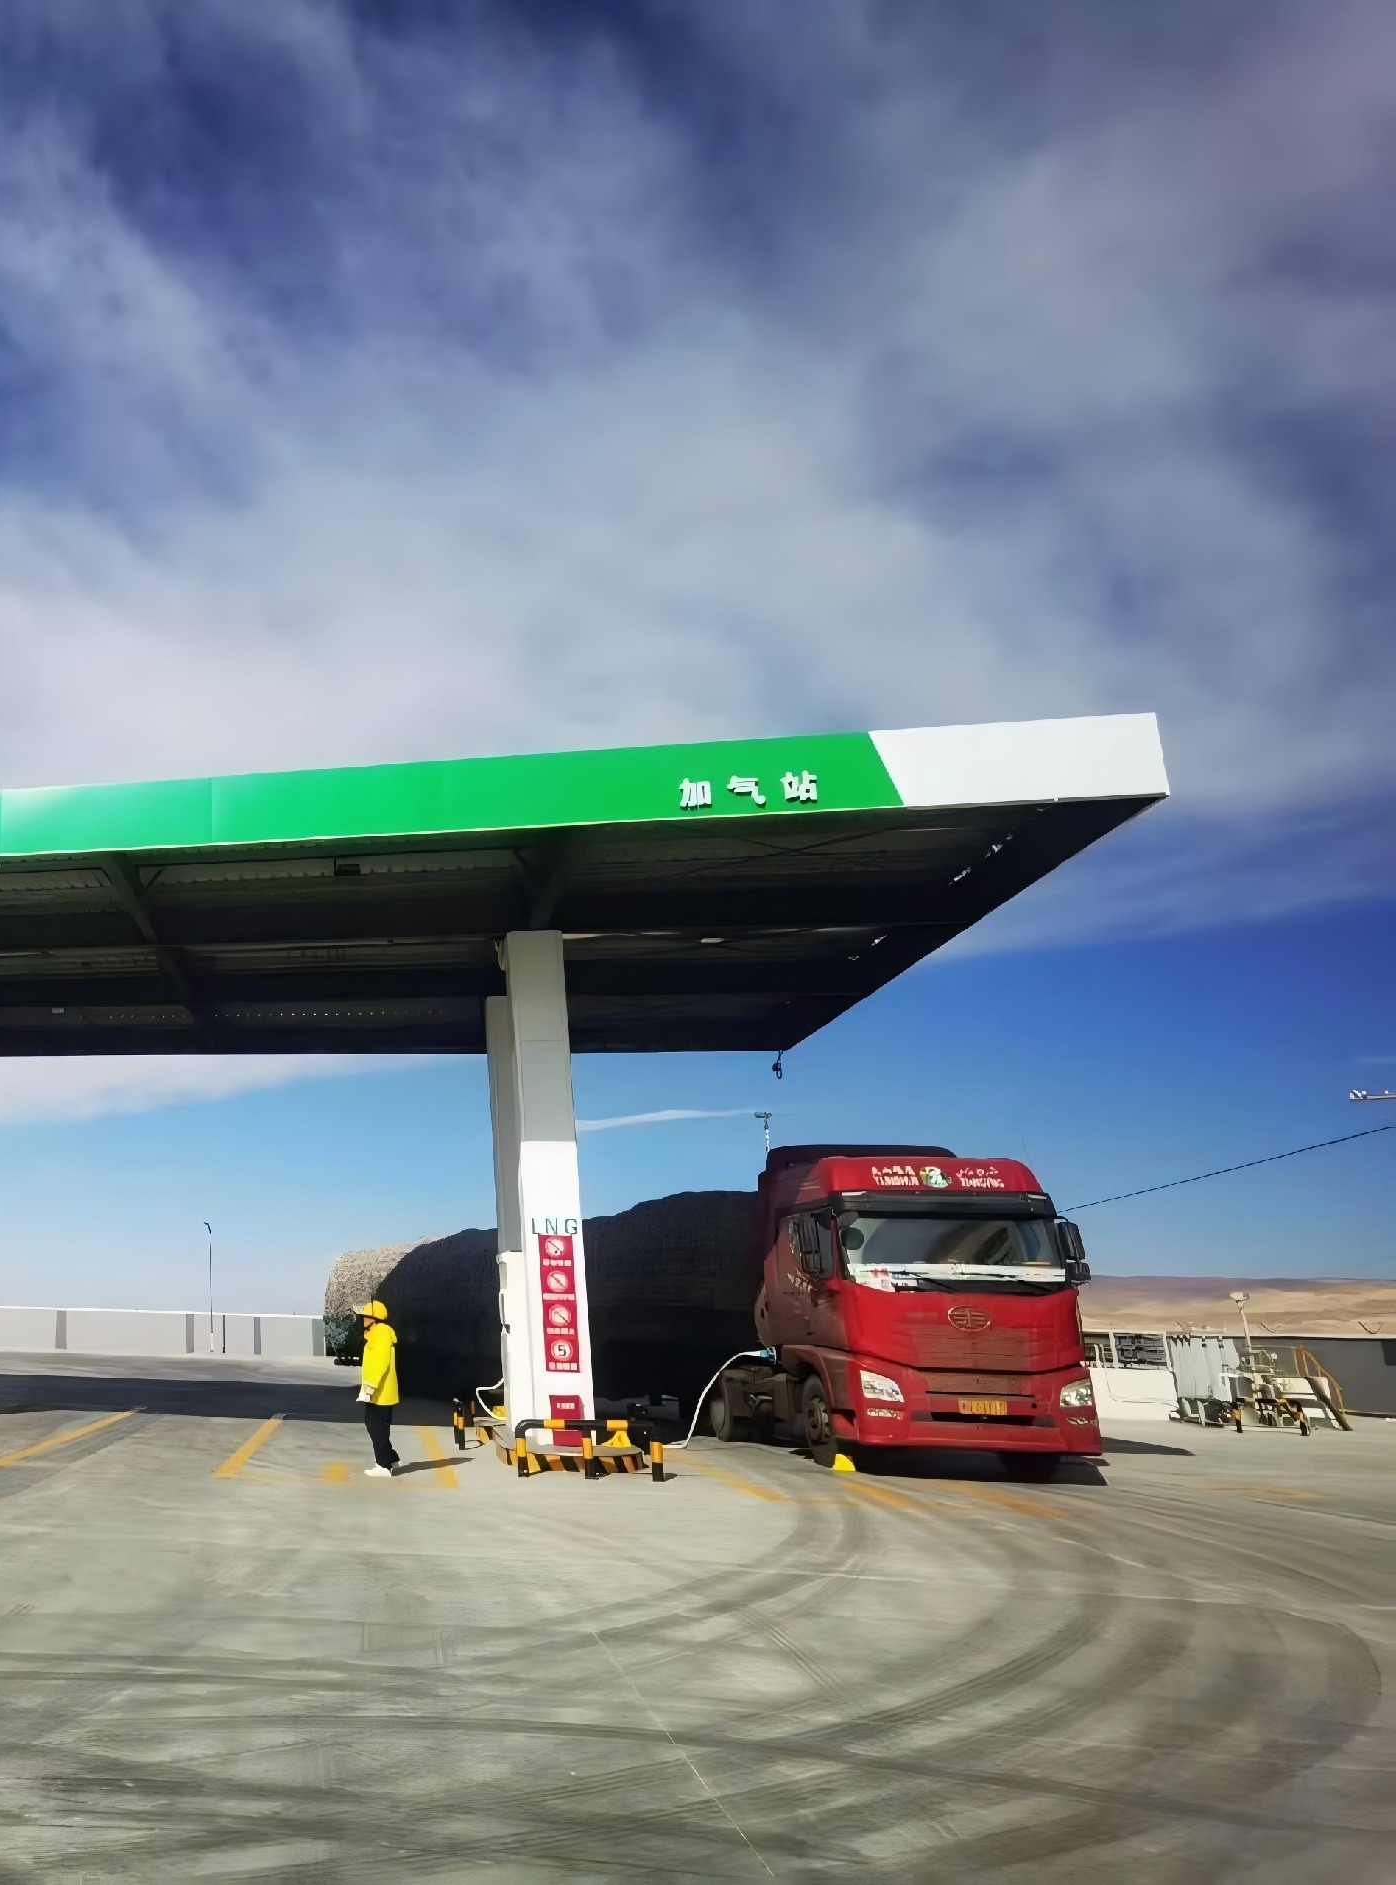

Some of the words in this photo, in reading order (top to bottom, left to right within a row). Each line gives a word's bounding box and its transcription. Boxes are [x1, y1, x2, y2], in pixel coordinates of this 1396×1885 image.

[679, 770, 819, 811] 加气站
[531, 1217, 578, 1235] LNG
